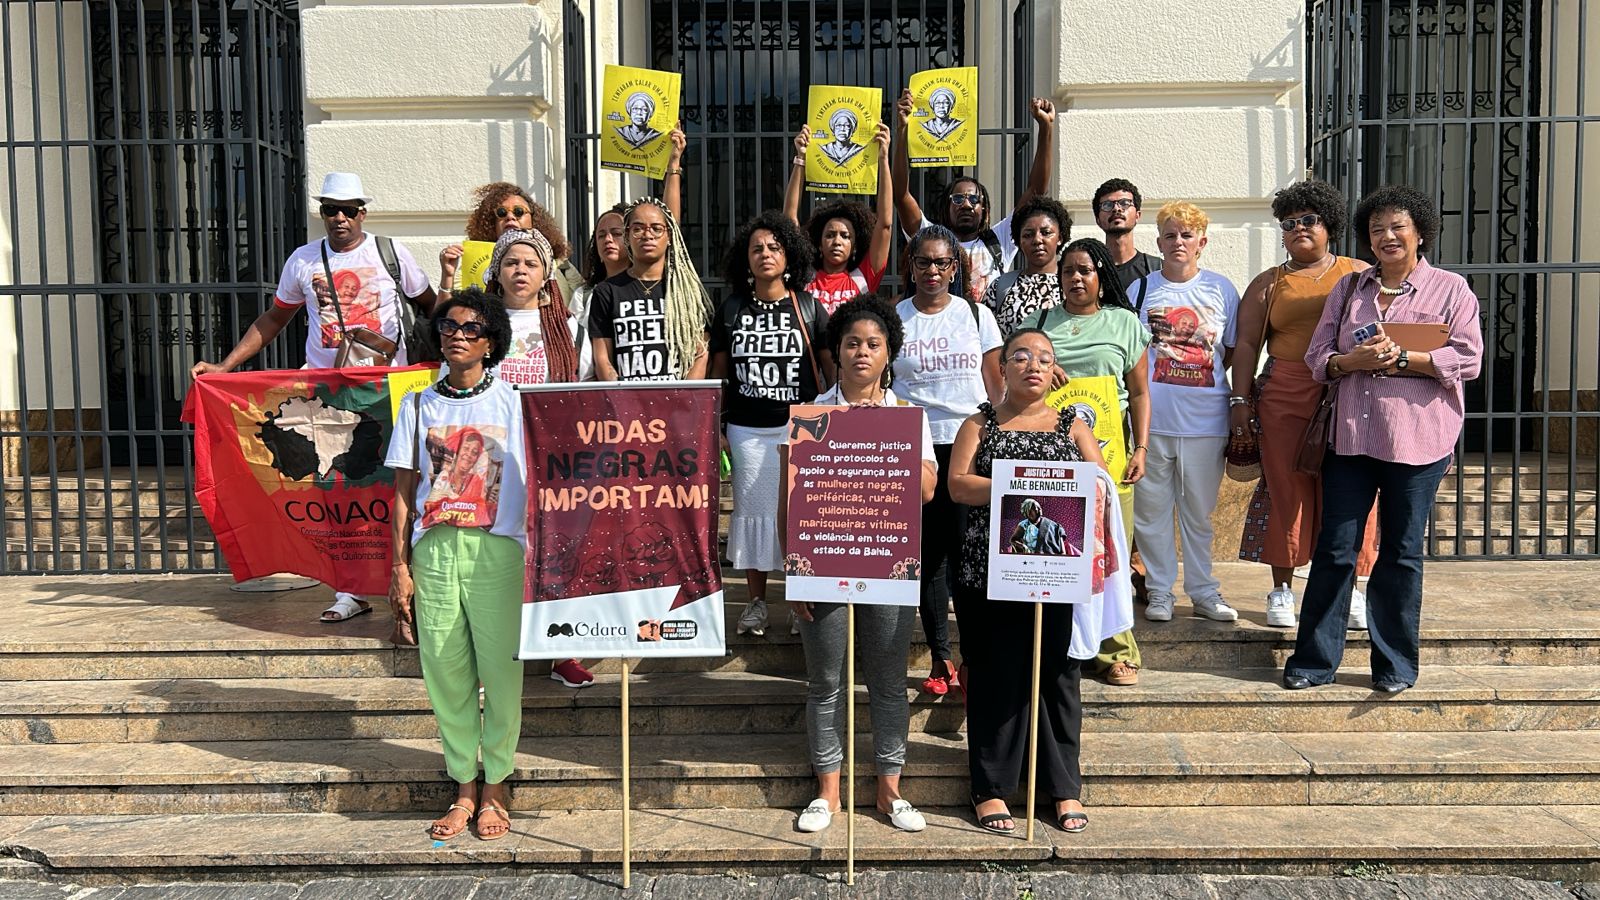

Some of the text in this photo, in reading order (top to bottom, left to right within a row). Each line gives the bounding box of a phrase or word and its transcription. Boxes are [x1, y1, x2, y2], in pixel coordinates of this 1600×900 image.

[741, 312, 791, 332] PELE
[615, 318, 665, 345] PRET
[732, 331, 801, 354] PRETA
[616, 346, 663, 377] NÃO
[914, 352, 978, 374] JUNTAS
[500, 372, 546, 385] NEGRAS
[735, 357, 801, 387] NÃO É
[576, 418, 667, 445] VIDAS
[828, 440, 912, 452] Queremos justiça
[546, 448, 699, 481] NEGRAS
[810, 455, 900, 464] com protocolos de
[799, 467, 911, 478] apoio e segurança para
[1023, 468, 1066, 478] JUSTIÇA POR
[803, 479, 906, 491] as mulheres negras,
[1009, 479, 1078, 492] MÃE BERNADETE!
[539, 484, 709, 512] IMPORTAM!
[806, 491, 902, 505] periféricas, rurais,
[284, 498, 391, 525] CONAQ
[818, 505, 889, 517] quilombolas e
[799, 518, 908, 530] marisqueiras vítimas
[798, 532, 811, 541] de
[814, 532, 855, 542] violência
[876, 534, 898, 543] todo
[813, 545, 893, 557] estado da Bahia.
[574, 621, 627, 637] Odara
